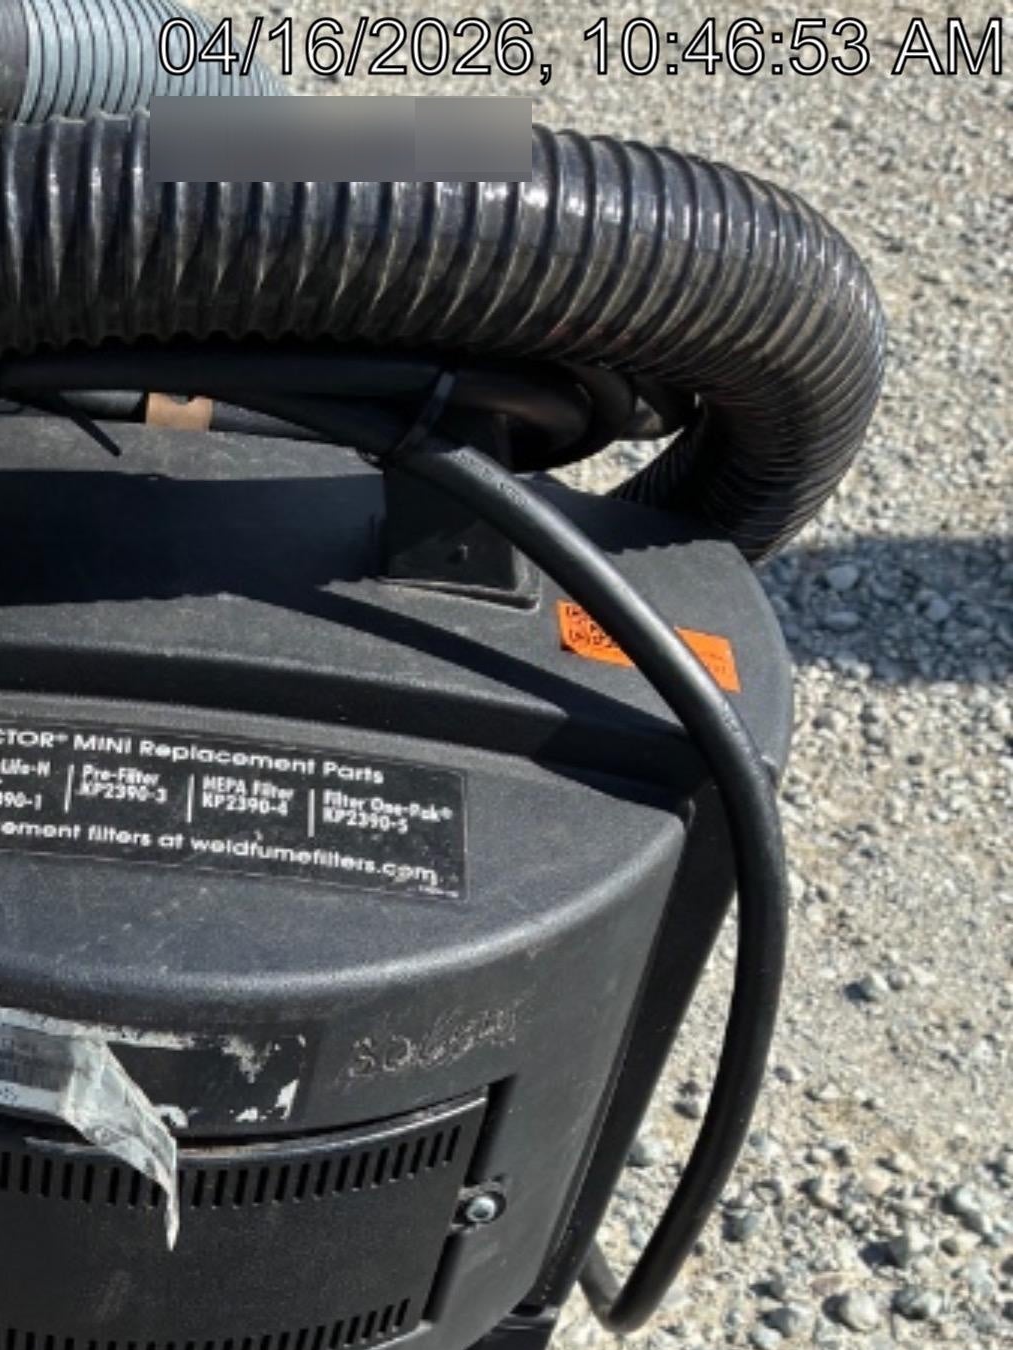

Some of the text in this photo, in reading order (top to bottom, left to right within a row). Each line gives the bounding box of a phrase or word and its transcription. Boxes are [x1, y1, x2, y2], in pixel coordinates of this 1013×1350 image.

[73, 734, 132, 754] MINI
[139, 739, 315, 776] Replacement
[322, 760, 384, 784] Parts
[82, 764, 160, 787] Pre-Filter
[202, 774, 295, 801] HEPA Filter
[323, 789, 365, 811] Filter
[88, 824, 151, 847] filters
[158, 833, 184, 850] at
[191, 836, 438, 887] weldfumefilters.com
